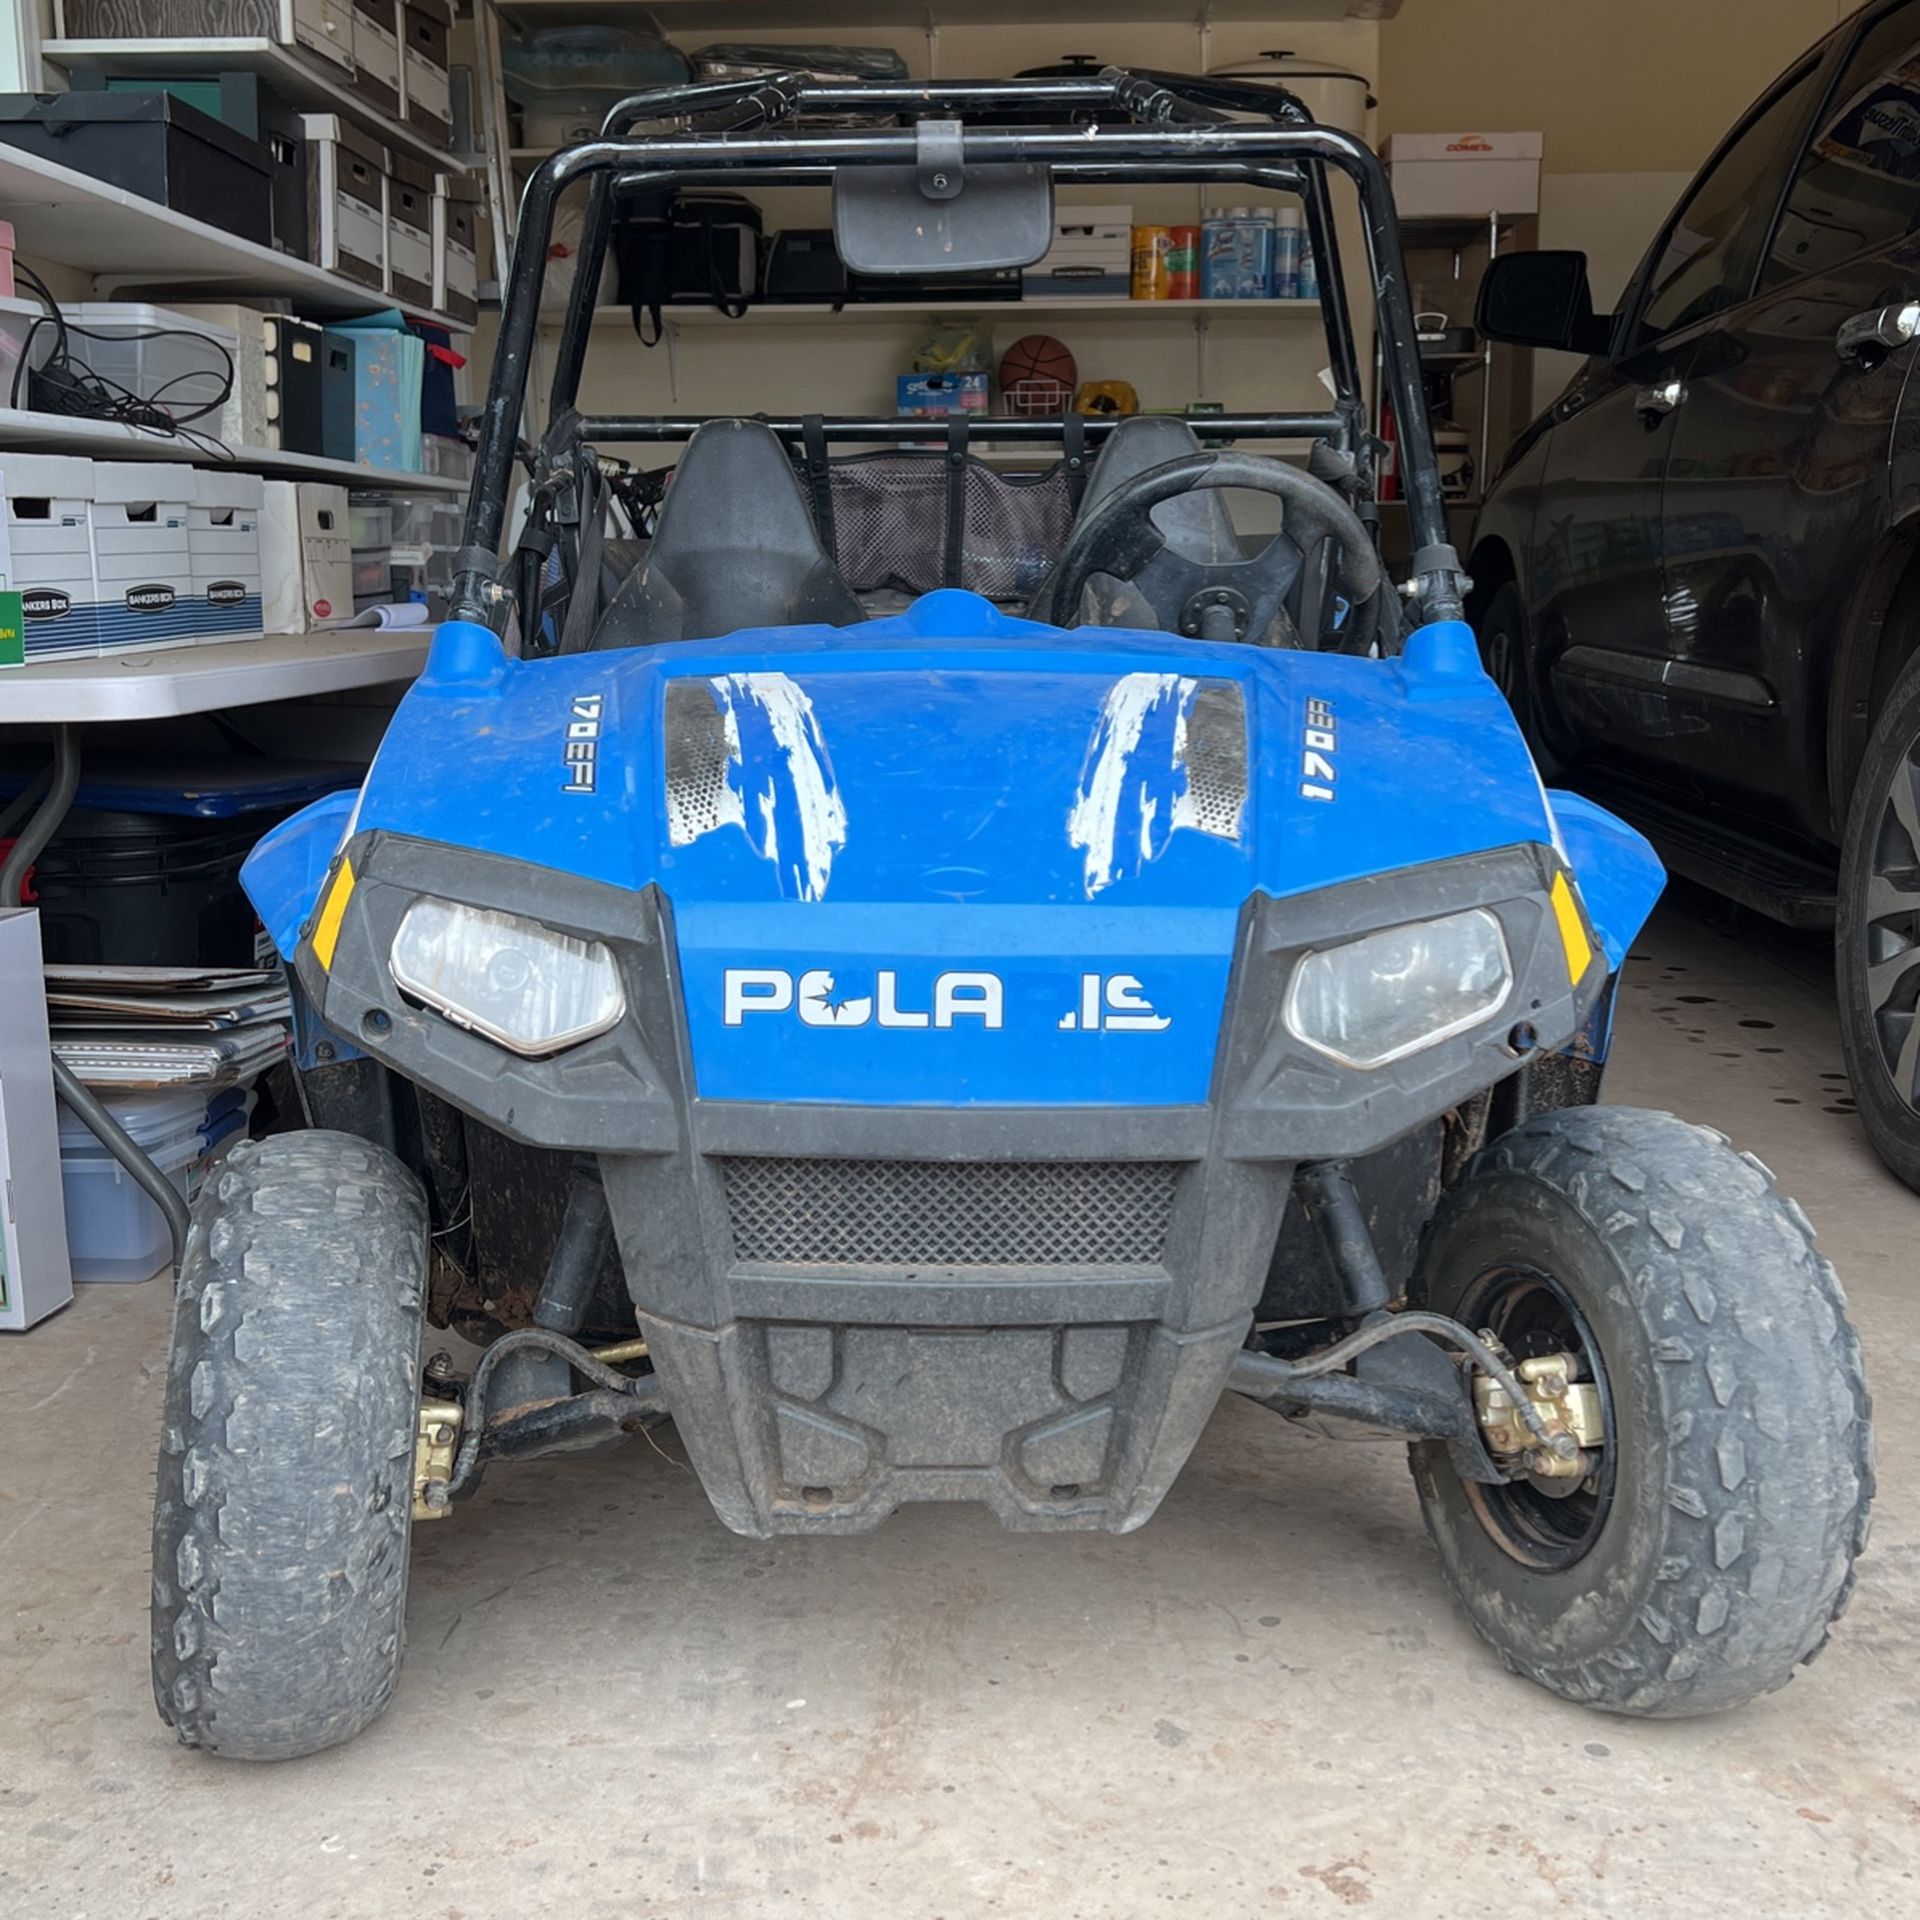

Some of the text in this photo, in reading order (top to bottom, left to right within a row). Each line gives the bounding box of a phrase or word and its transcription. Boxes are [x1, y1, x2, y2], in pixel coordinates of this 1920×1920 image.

[964, 376, 980, 388] 24
[51, 599, 68, 610] BOX
[723, 968, 1172, 1031] POLAIS
